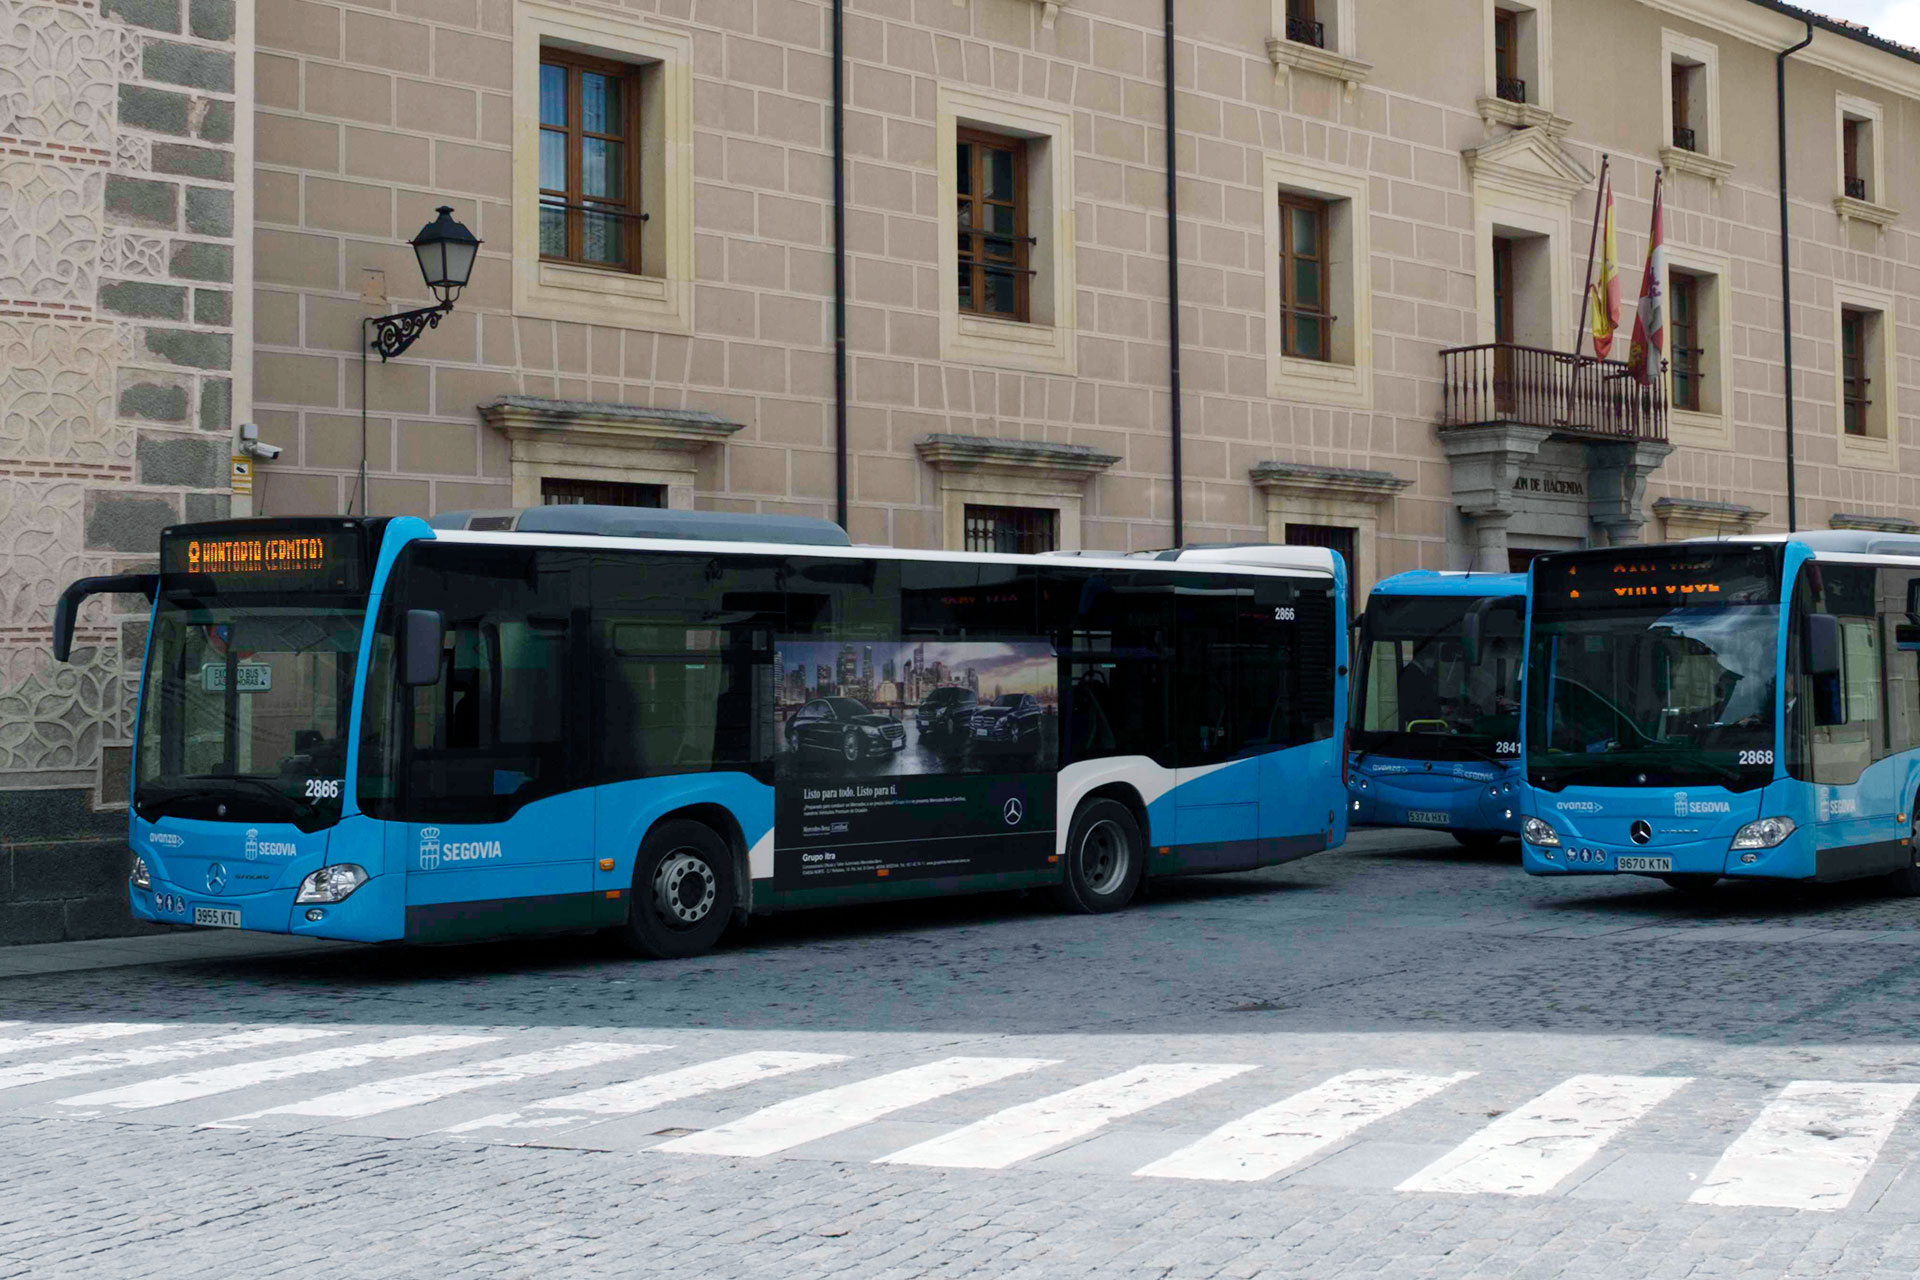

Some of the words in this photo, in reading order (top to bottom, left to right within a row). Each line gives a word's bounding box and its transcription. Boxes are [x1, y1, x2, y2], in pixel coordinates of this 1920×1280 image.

[1530, 478, 1541, 491] DE
[1543, 479, 1583, 495] HACIENDA
[1275, 607, 1295, 621] 2866
[245, 668, 259, 678] BUS
[1496, 741, 1521, 754] 2841
[1739, 750, 1774, 765] 2868
[305, 779, 339, 798] 2866
[803, 788, 821, 800] Listo
[822, 789, 838, 801] para
[839, 786, 855, 798] todo.
[857, 785, 873, 797] Listo
[874, 787, 889, 799] para
[1556, 801, 1593, 810] avanza
[1689, 801, 1730, 813] SEGOVIA
[1830, 799, 1856, 814] SEGOVIA
[149, 833, 177, 844] avanza
[258, 842, 297, 857] SEGOVIA
[443, 840, 502, 862] SEGOVIA
[802, 853, 824, 863] Grupo
[1619, 858, 1645, 869] 9670
[1648, 858, 1669, 870] KTN
[197, 909, 218, 924] 3955
[221, 911, 238, 926] KTL
